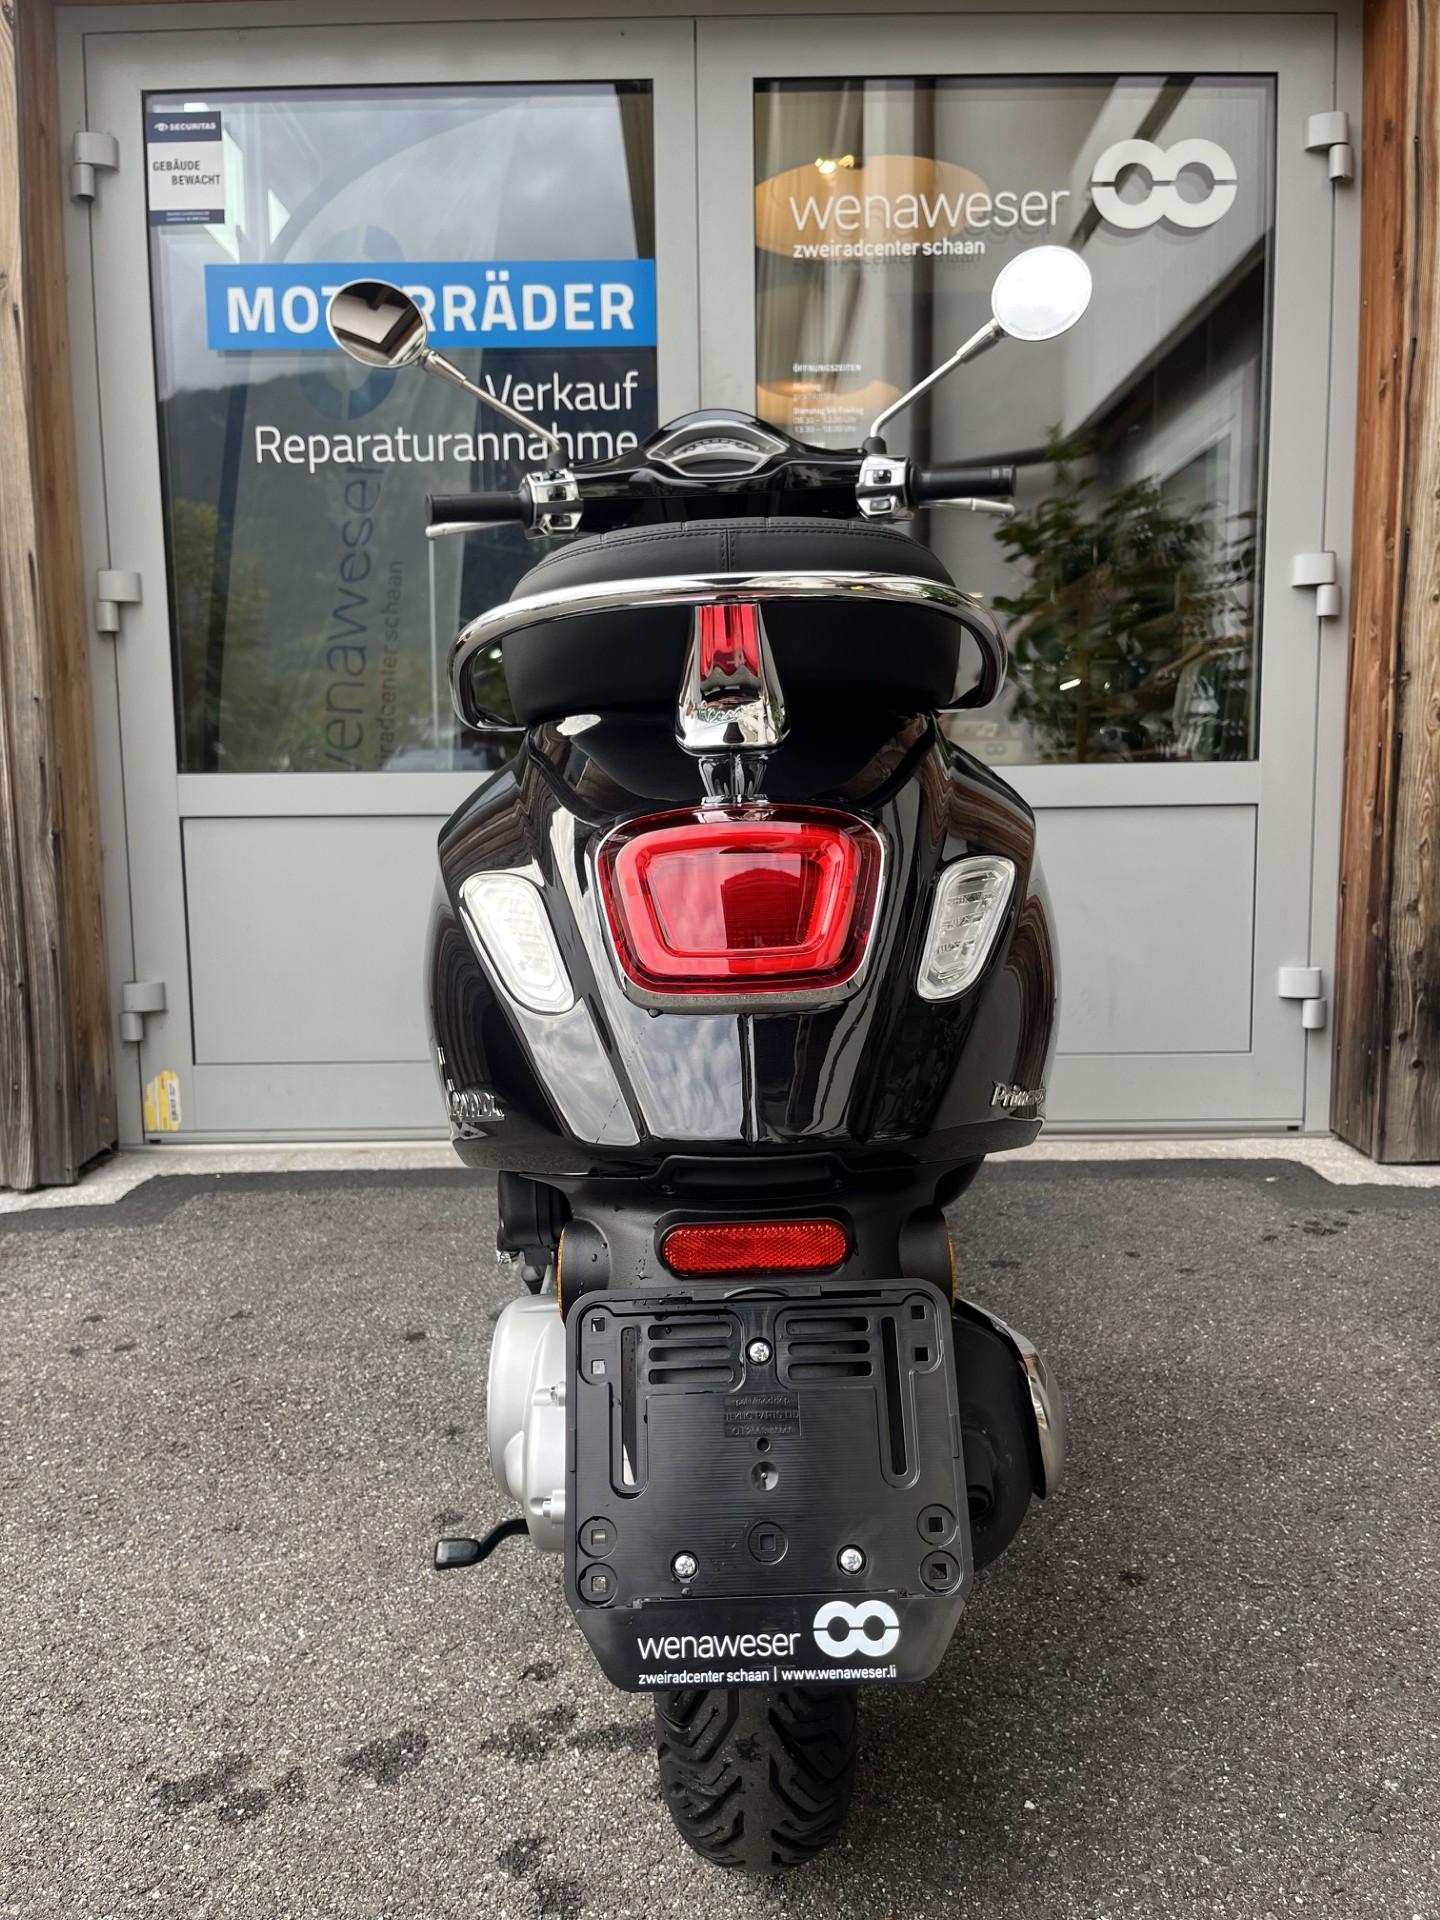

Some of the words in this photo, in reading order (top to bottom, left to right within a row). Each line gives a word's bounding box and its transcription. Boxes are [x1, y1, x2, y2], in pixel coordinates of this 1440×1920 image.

[168, 122, 217, 132] SECURITAS
[152, 159, 201, 172] GEBÄUDE
[171, 174, 221, 186] BEWACHT
[789, 190, 1071, 231] wenaweser
[922, 237, 986, 257] schaan
[226, 271, 636, 334] MORRÄDER
[485, 371, 639, 412] Verkauf
[255, 422, 639, 475] Reparaturannahme
[637, 1632, 801, 1660] wenaweser
[638, 1670, 724, 1685] zweiradcenter
[726, 1668, 769, 1682] schaan
[781, 1664, 897, 1681] www.wenaweser.li
